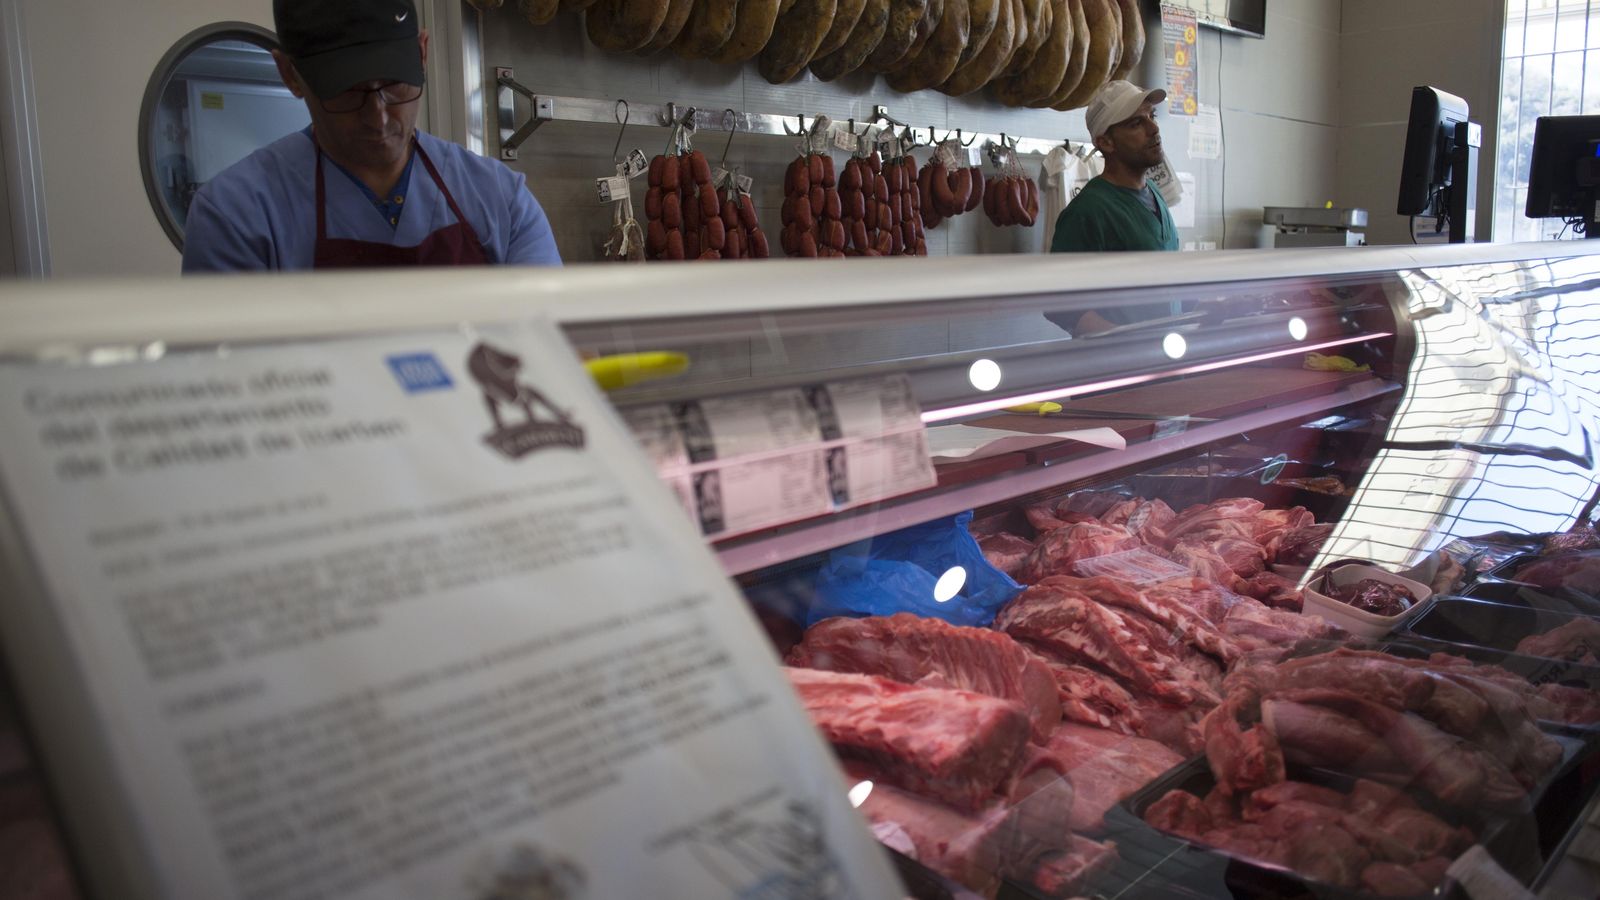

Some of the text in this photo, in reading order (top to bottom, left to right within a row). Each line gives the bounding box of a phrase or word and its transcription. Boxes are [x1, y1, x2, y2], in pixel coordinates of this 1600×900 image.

[24, 376, 243, 414] Comunicado
[40, 398, 332, 448] del departamento
[56, 454, 105, 481] de
[112, 434, 247, 473] Calidad
[254, 428, 295, 453] de
